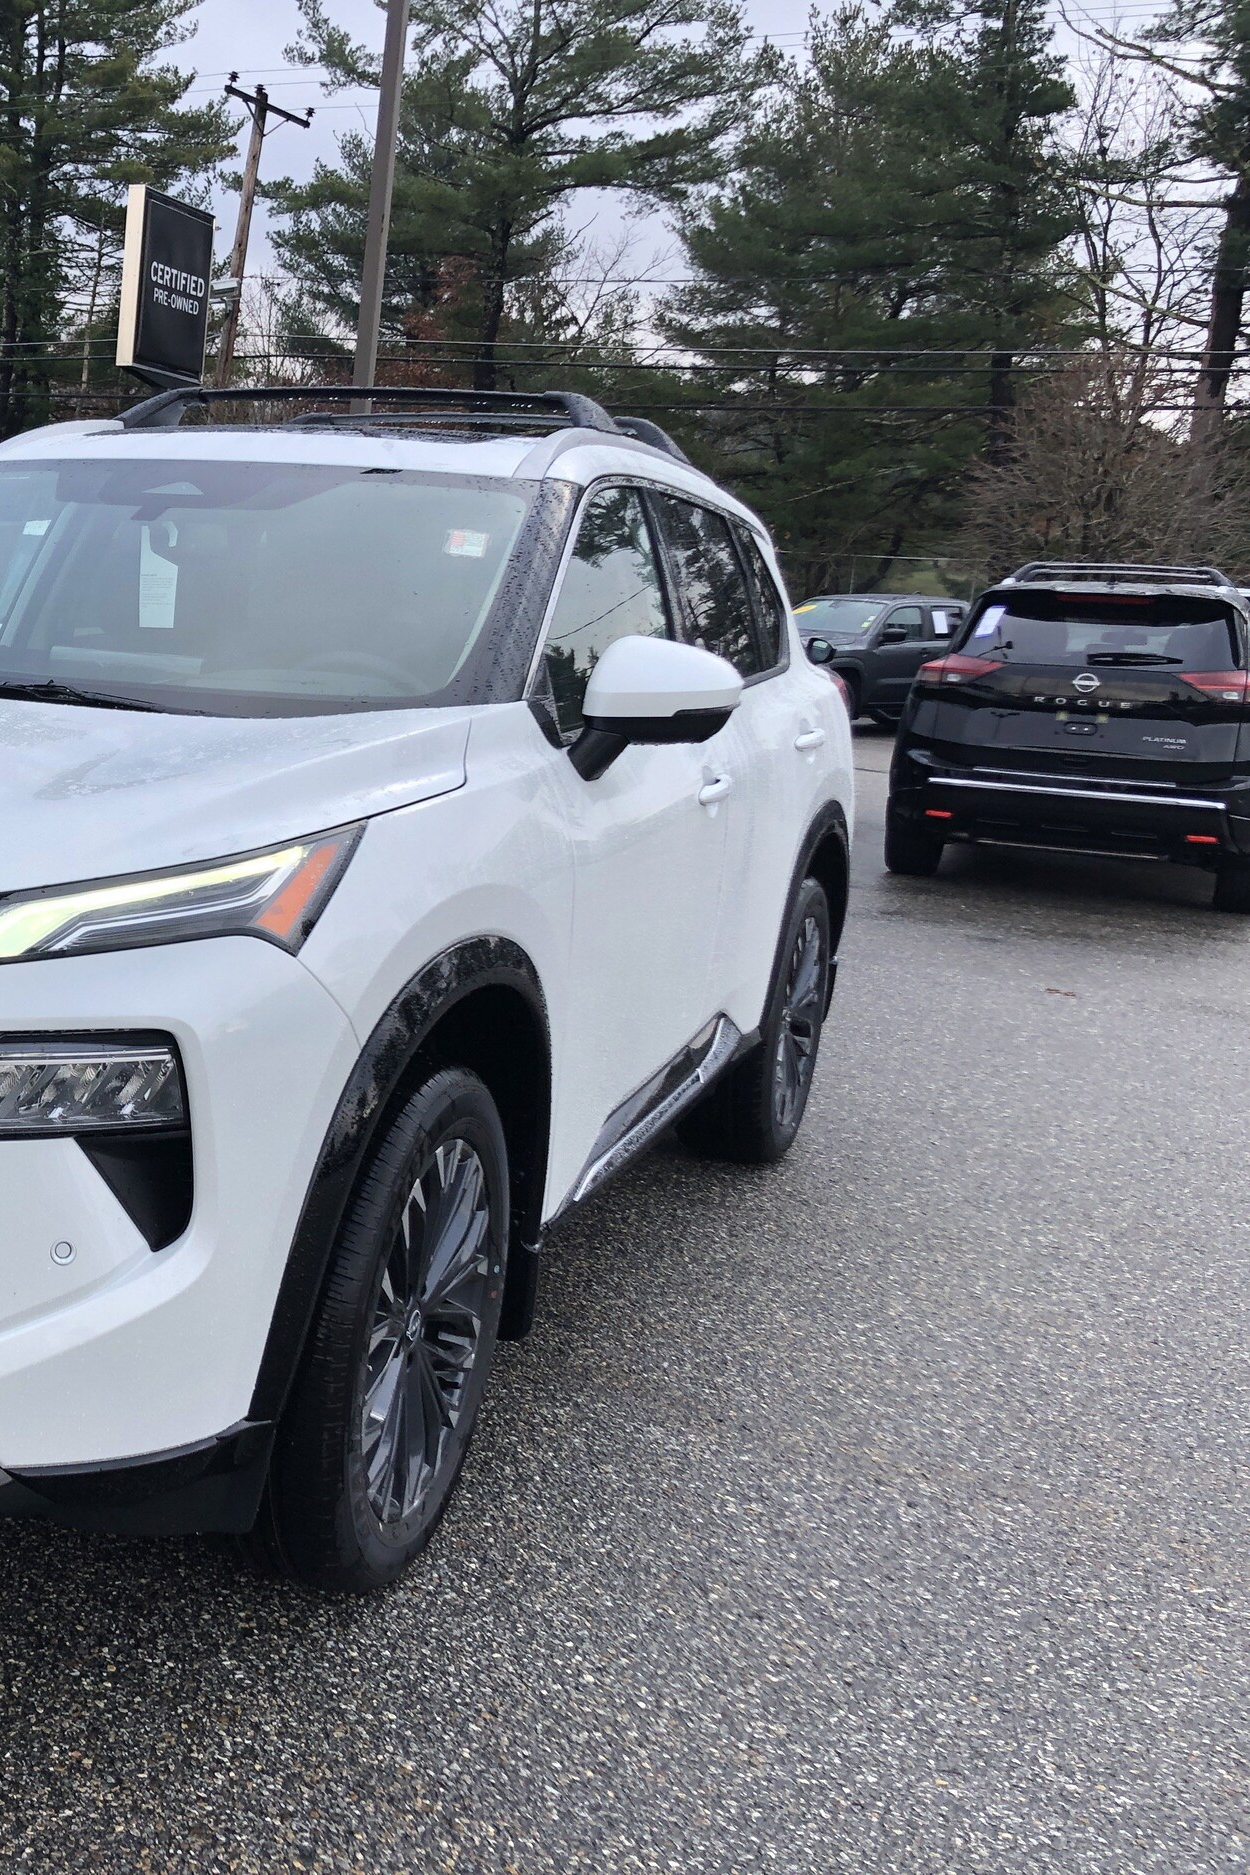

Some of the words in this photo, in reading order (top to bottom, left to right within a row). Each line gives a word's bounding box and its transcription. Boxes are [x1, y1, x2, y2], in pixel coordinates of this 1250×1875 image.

[151, 261, 205, 297] CERTIFIED
[153, 288, 199, 315] PRE-OWNED
[1034, 696, 1132, 709] ROGUE
[1142, 736, 1187, 744] PLATINUM
